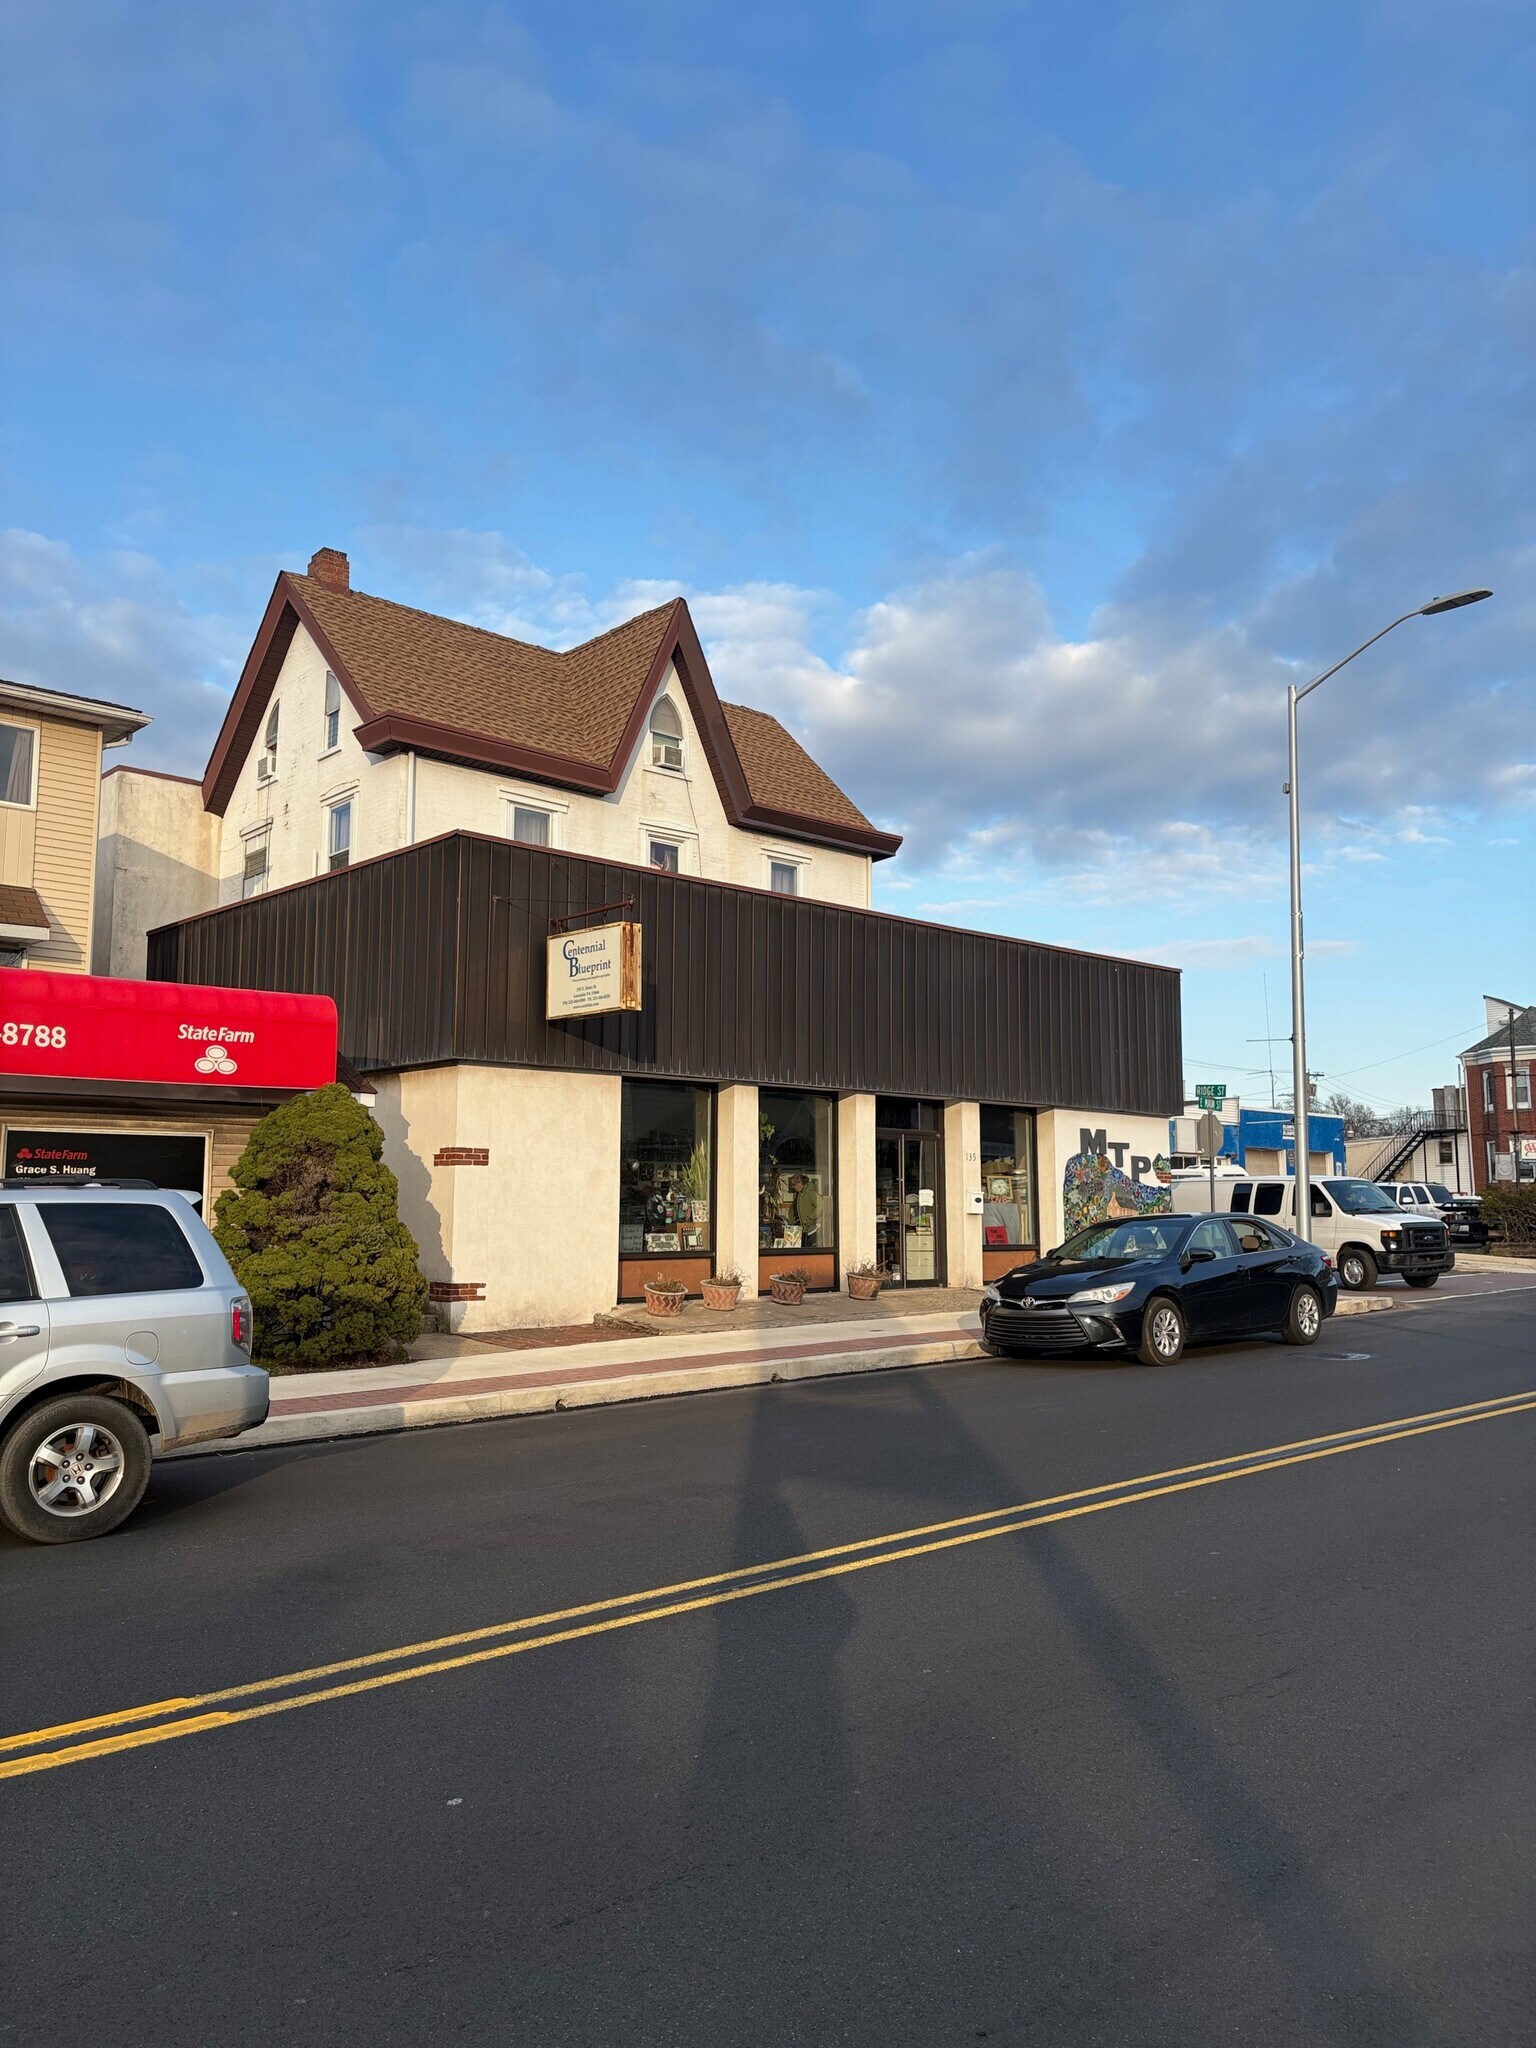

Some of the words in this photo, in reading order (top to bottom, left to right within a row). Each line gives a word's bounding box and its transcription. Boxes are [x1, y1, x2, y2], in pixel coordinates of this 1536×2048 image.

[563, 939, 606, 960] Centennial
[569, 957, 611, 978] Blueprint
[0, 1022, 66, 1049] 8788
[1197, 1086, 1214, 1096] RIDGE
[1217, 1086, 1225, 1096] ST
[1216, 1100, 1222, 1110] ST
[15, 1164, 47, 1174] Grace
[49, 1165, 60, 1174] S.
[62, 1165, 96, 1177] Huang
